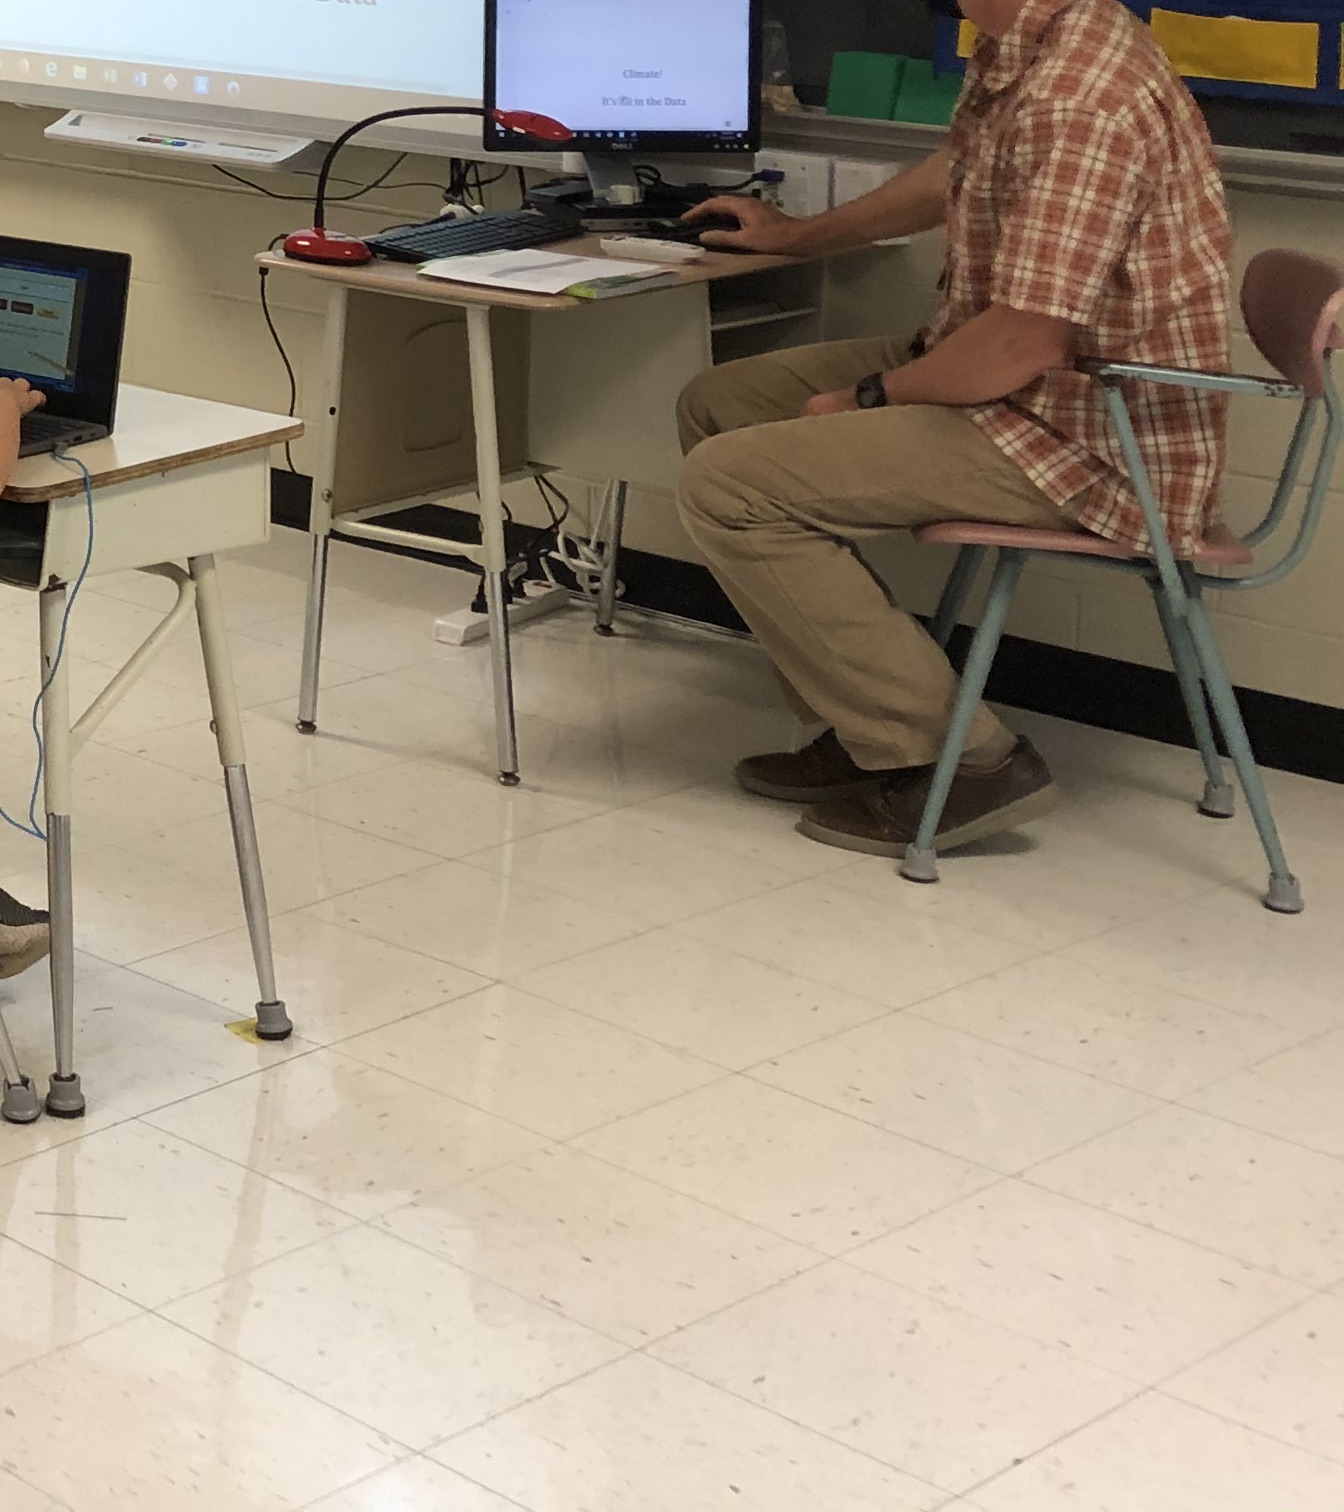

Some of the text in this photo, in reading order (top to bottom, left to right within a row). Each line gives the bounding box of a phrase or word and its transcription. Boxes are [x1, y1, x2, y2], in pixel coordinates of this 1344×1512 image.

[622, 69, 663, 79] Climate!
[634, 97, 644, 106] in
[646, 96, 662, 106] the
[663, 97, 687, 107] Data
